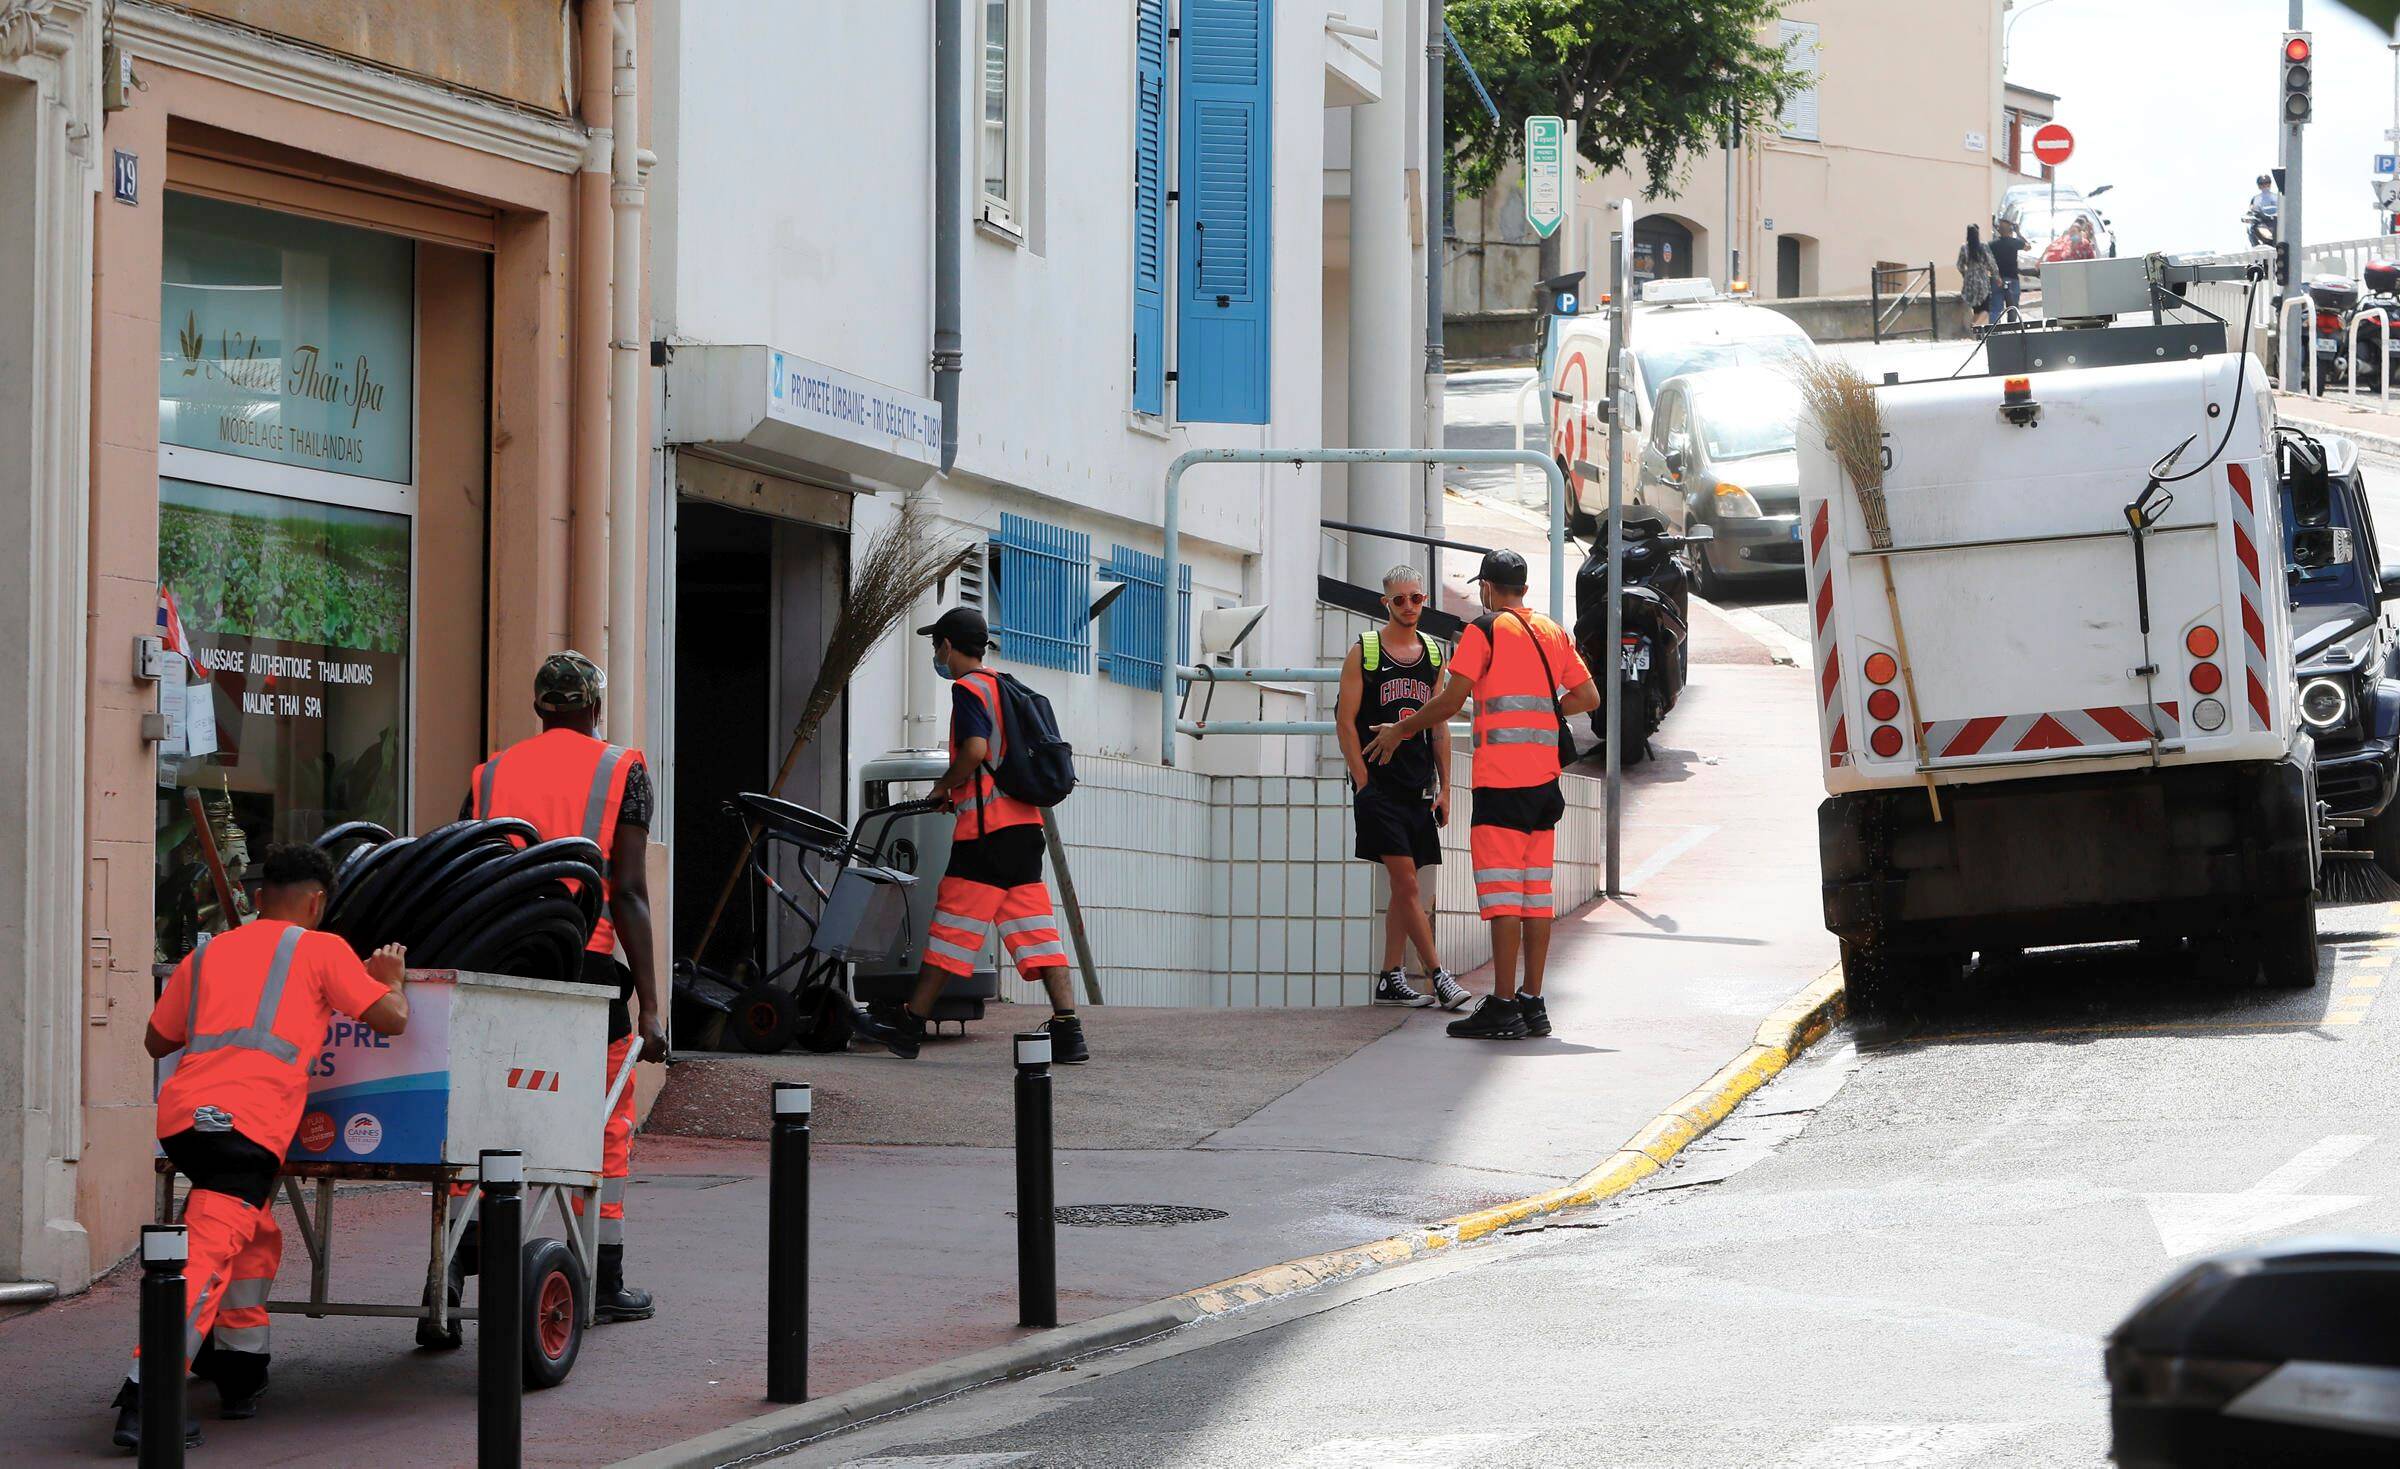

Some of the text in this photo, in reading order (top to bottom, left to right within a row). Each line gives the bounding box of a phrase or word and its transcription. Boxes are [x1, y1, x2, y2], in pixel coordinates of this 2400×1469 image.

[119, 157, 136, 195] 19
[2383, 158, 2392, 170] P
[1563, 293, 1575, 311] P
[288, 345, 343, 402] Thaï
[344, 354, 384, 429] Spa
[791, 374, 830, 416] PROPRETÉ
[832, 385, 865, 426] URBAINE
[872, 398, 884, 432] TRI
[885, 396, 916, 441] SÉLECTIF
[219, 415, 364, 464] MODELAGE THAILANDAIS
[200, 648, 373, 686] MASSAGE AUTHENTIQUE THAILANDAIS
[243, 691, 322, 718] NALINE THAI SPA
[348, 1128, 379, 1137] CANNES
